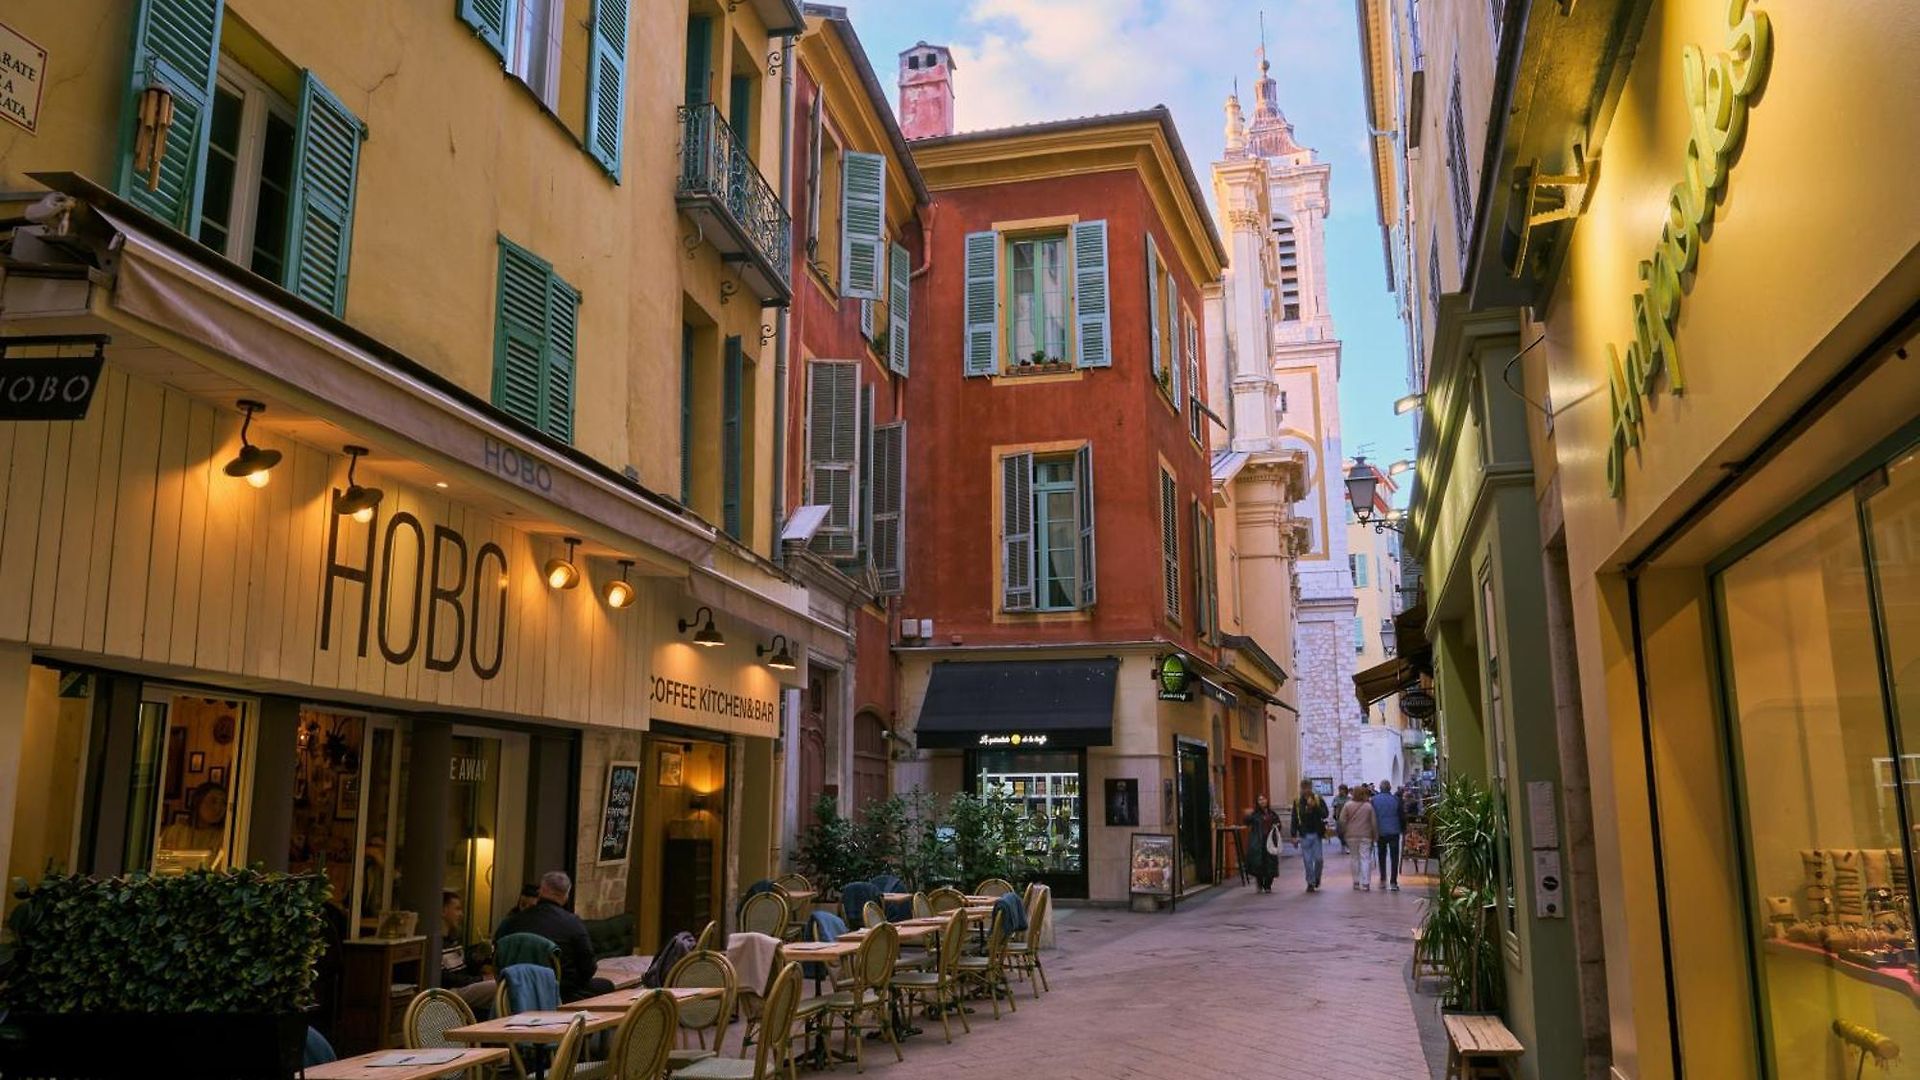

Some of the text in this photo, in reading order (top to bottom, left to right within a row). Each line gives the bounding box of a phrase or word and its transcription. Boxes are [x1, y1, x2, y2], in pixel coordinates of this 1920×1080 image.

[0, 51, 37, 82] RATE
[484, 436, 552, 492] HOBO
[320, 487, 508, 681] HOBO
[459, 757, 489, 781] AWAY
